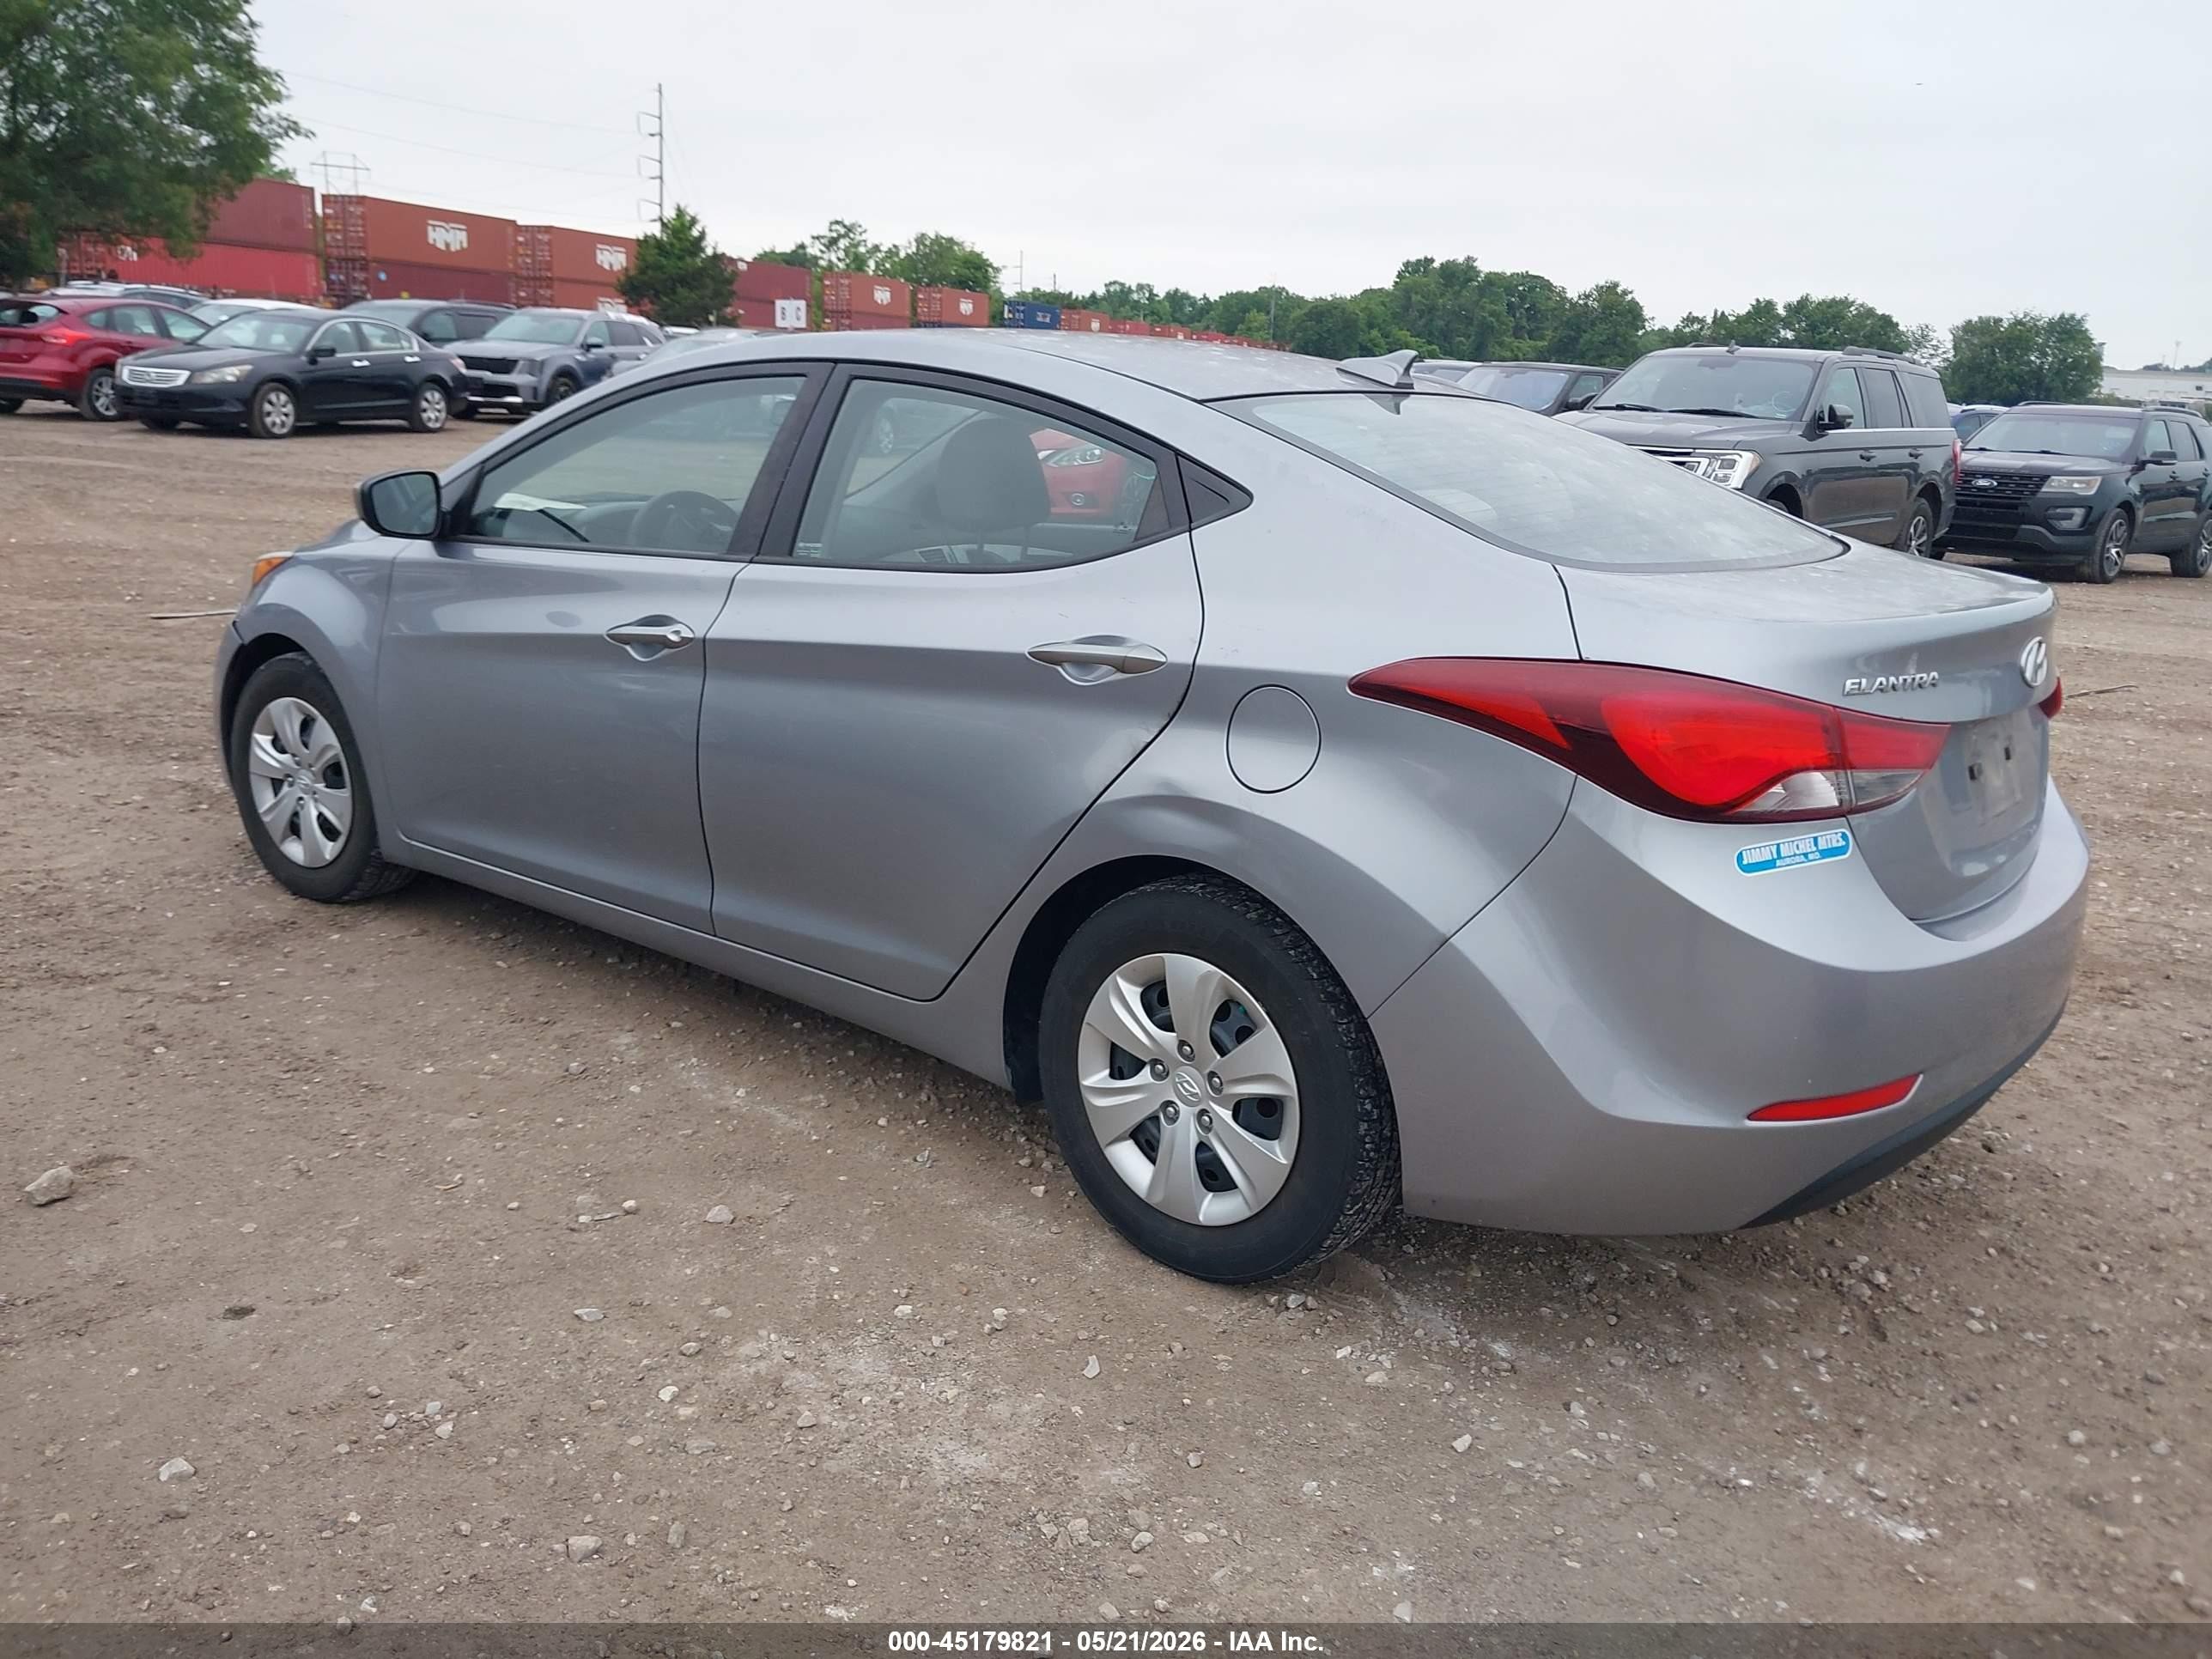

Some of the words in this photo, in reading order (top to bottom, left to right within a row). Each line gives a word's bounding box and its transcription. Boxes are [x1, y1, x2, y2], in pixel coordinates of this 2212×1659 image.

[1843, 671, 1940, 696] ELANTRA
[1741, 844, 1778, 866] JIMMY
[1779, 836, 1817, 858] MICHEL
